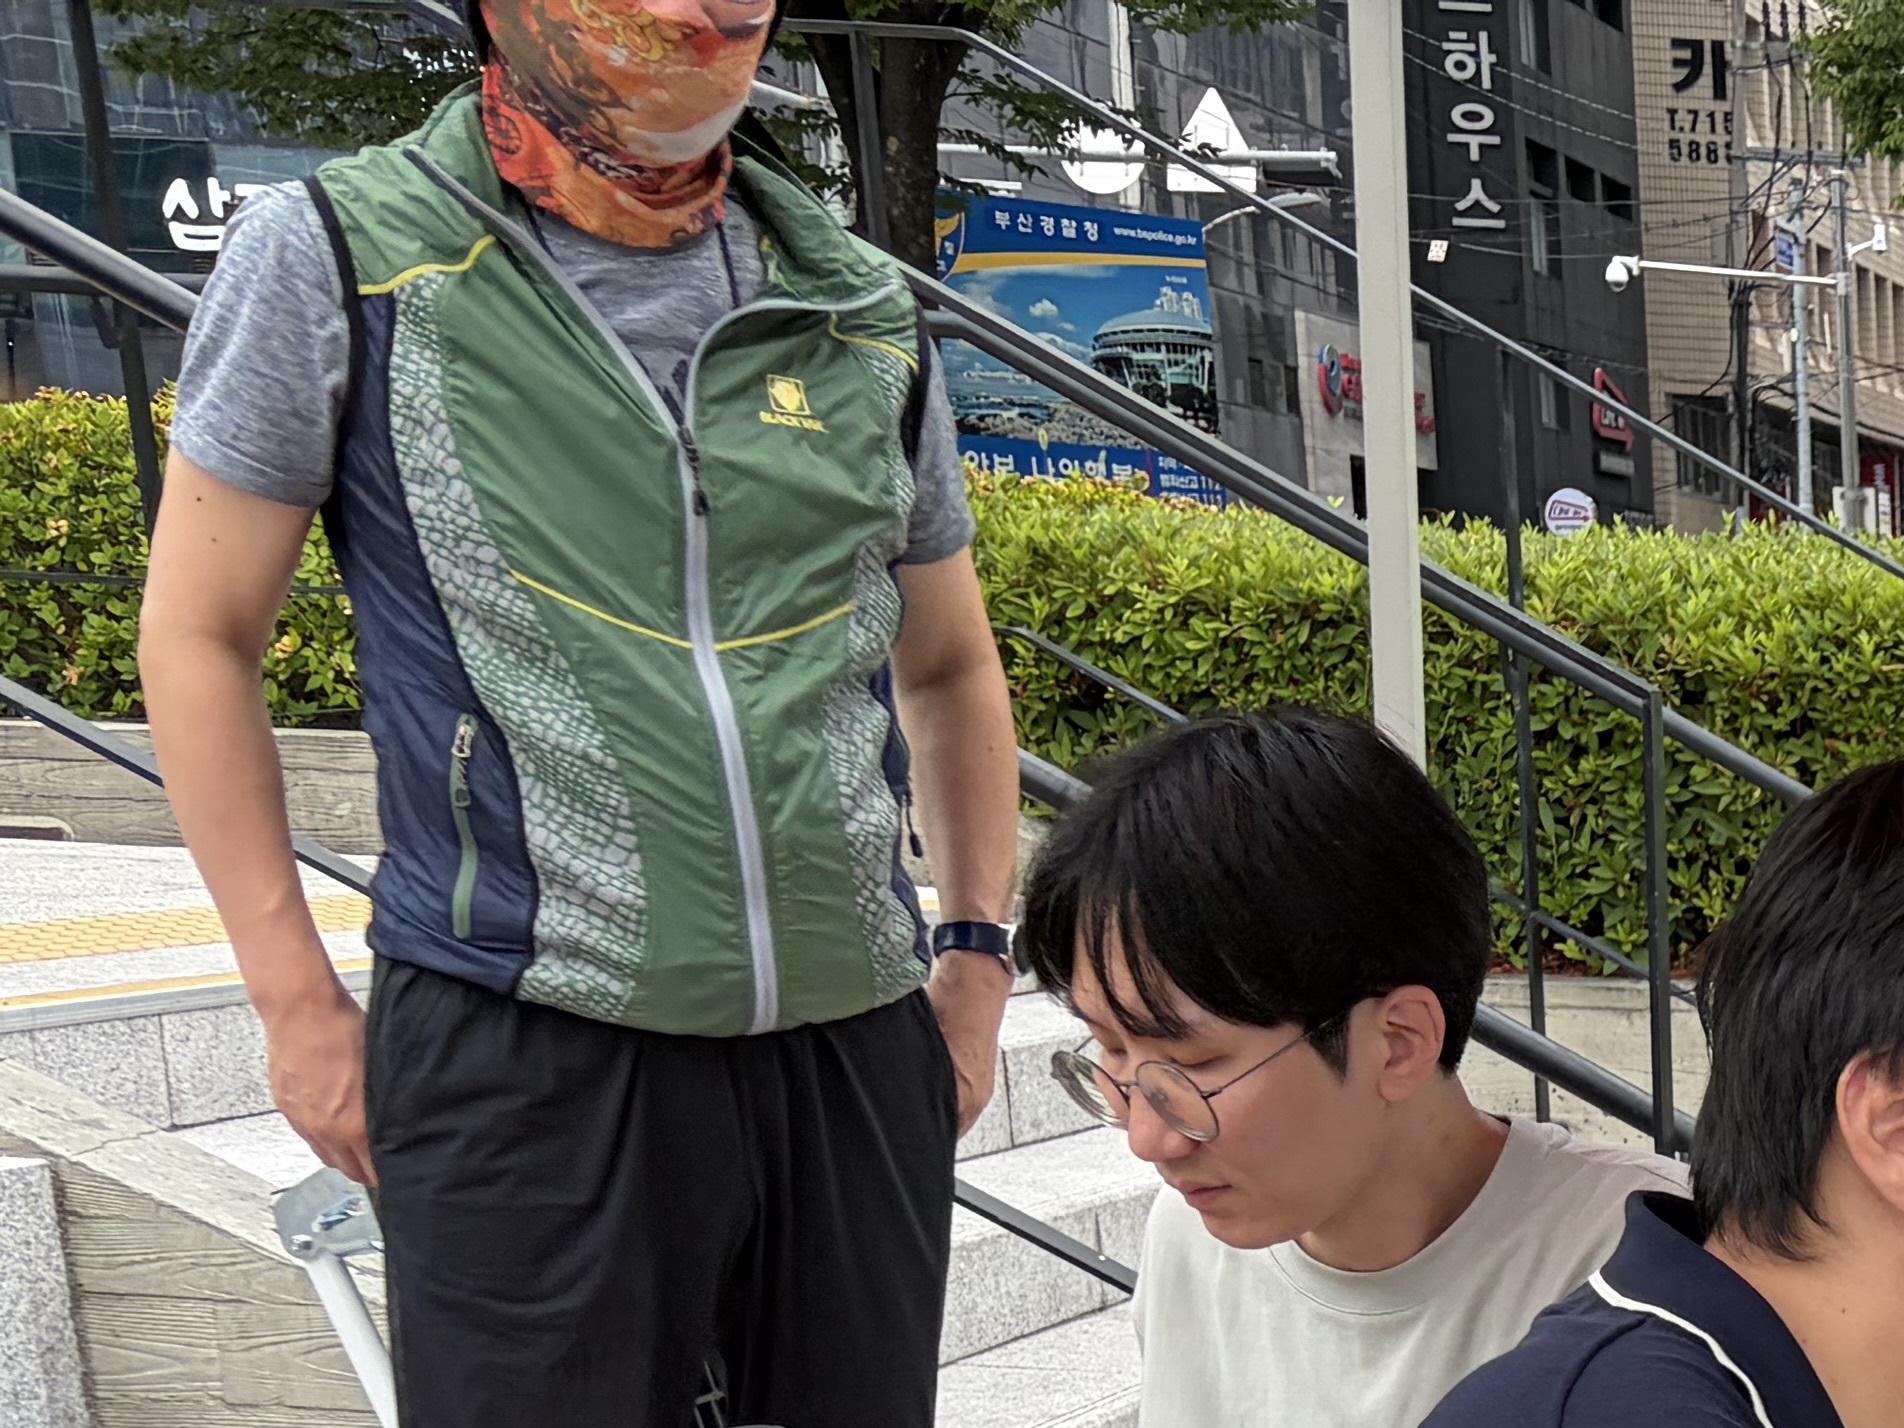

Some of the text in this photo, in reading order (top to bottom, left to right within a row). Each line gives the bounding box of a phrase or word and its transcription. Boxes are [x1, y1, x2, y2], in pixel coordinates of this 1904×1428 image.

[1438, 0, 1507, 229] 하우스
[162, 176, 270, 251] 삼
[994, 210, 1100, 242] 부산경찰청
